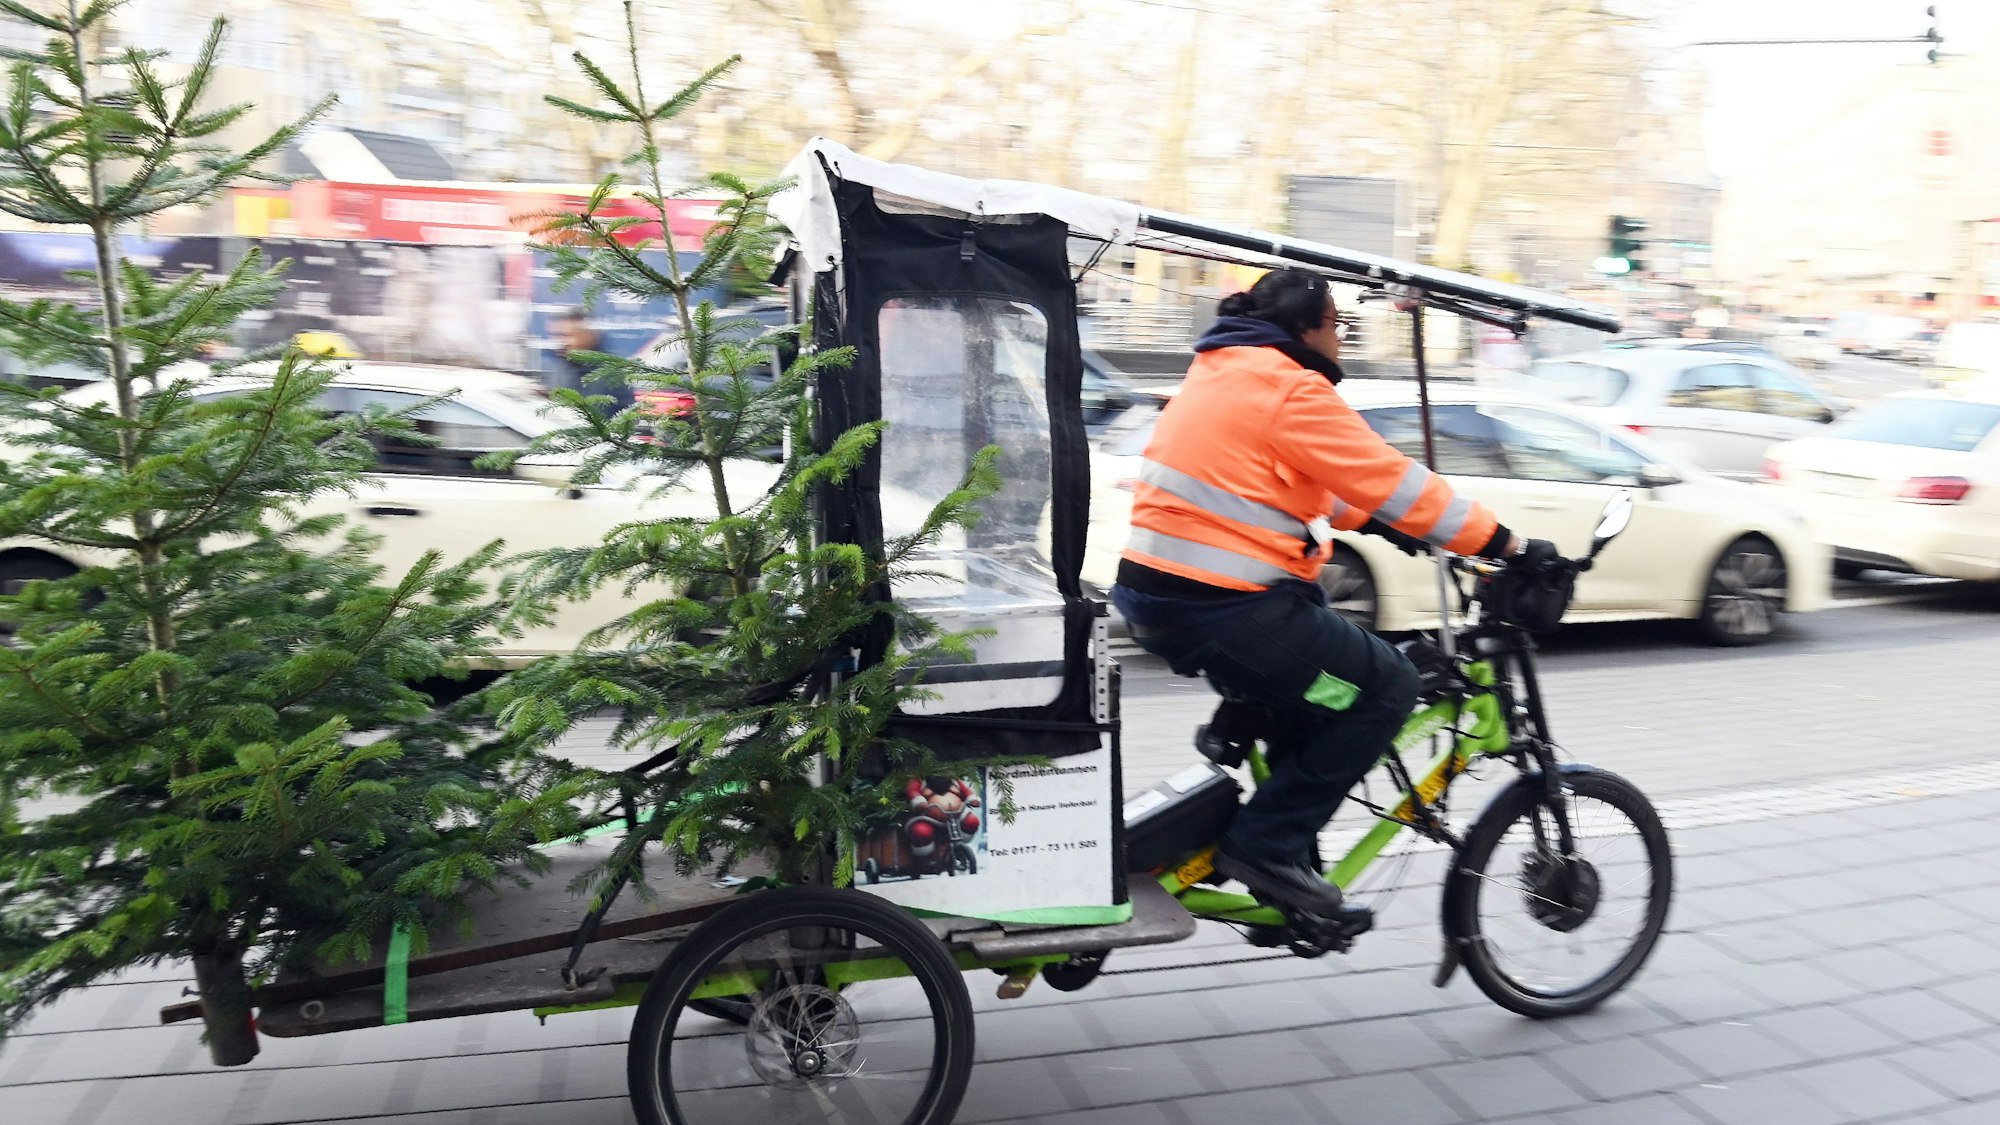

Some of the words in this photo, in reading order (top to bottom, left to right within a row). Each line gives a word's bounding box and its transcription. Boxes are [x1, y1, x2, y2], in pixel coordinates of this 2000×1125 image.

[990, 848, 1008, 857] Tel:
[1011, 845, 1037, 855] 0177
[1064, 842, 1075, 850] 11
